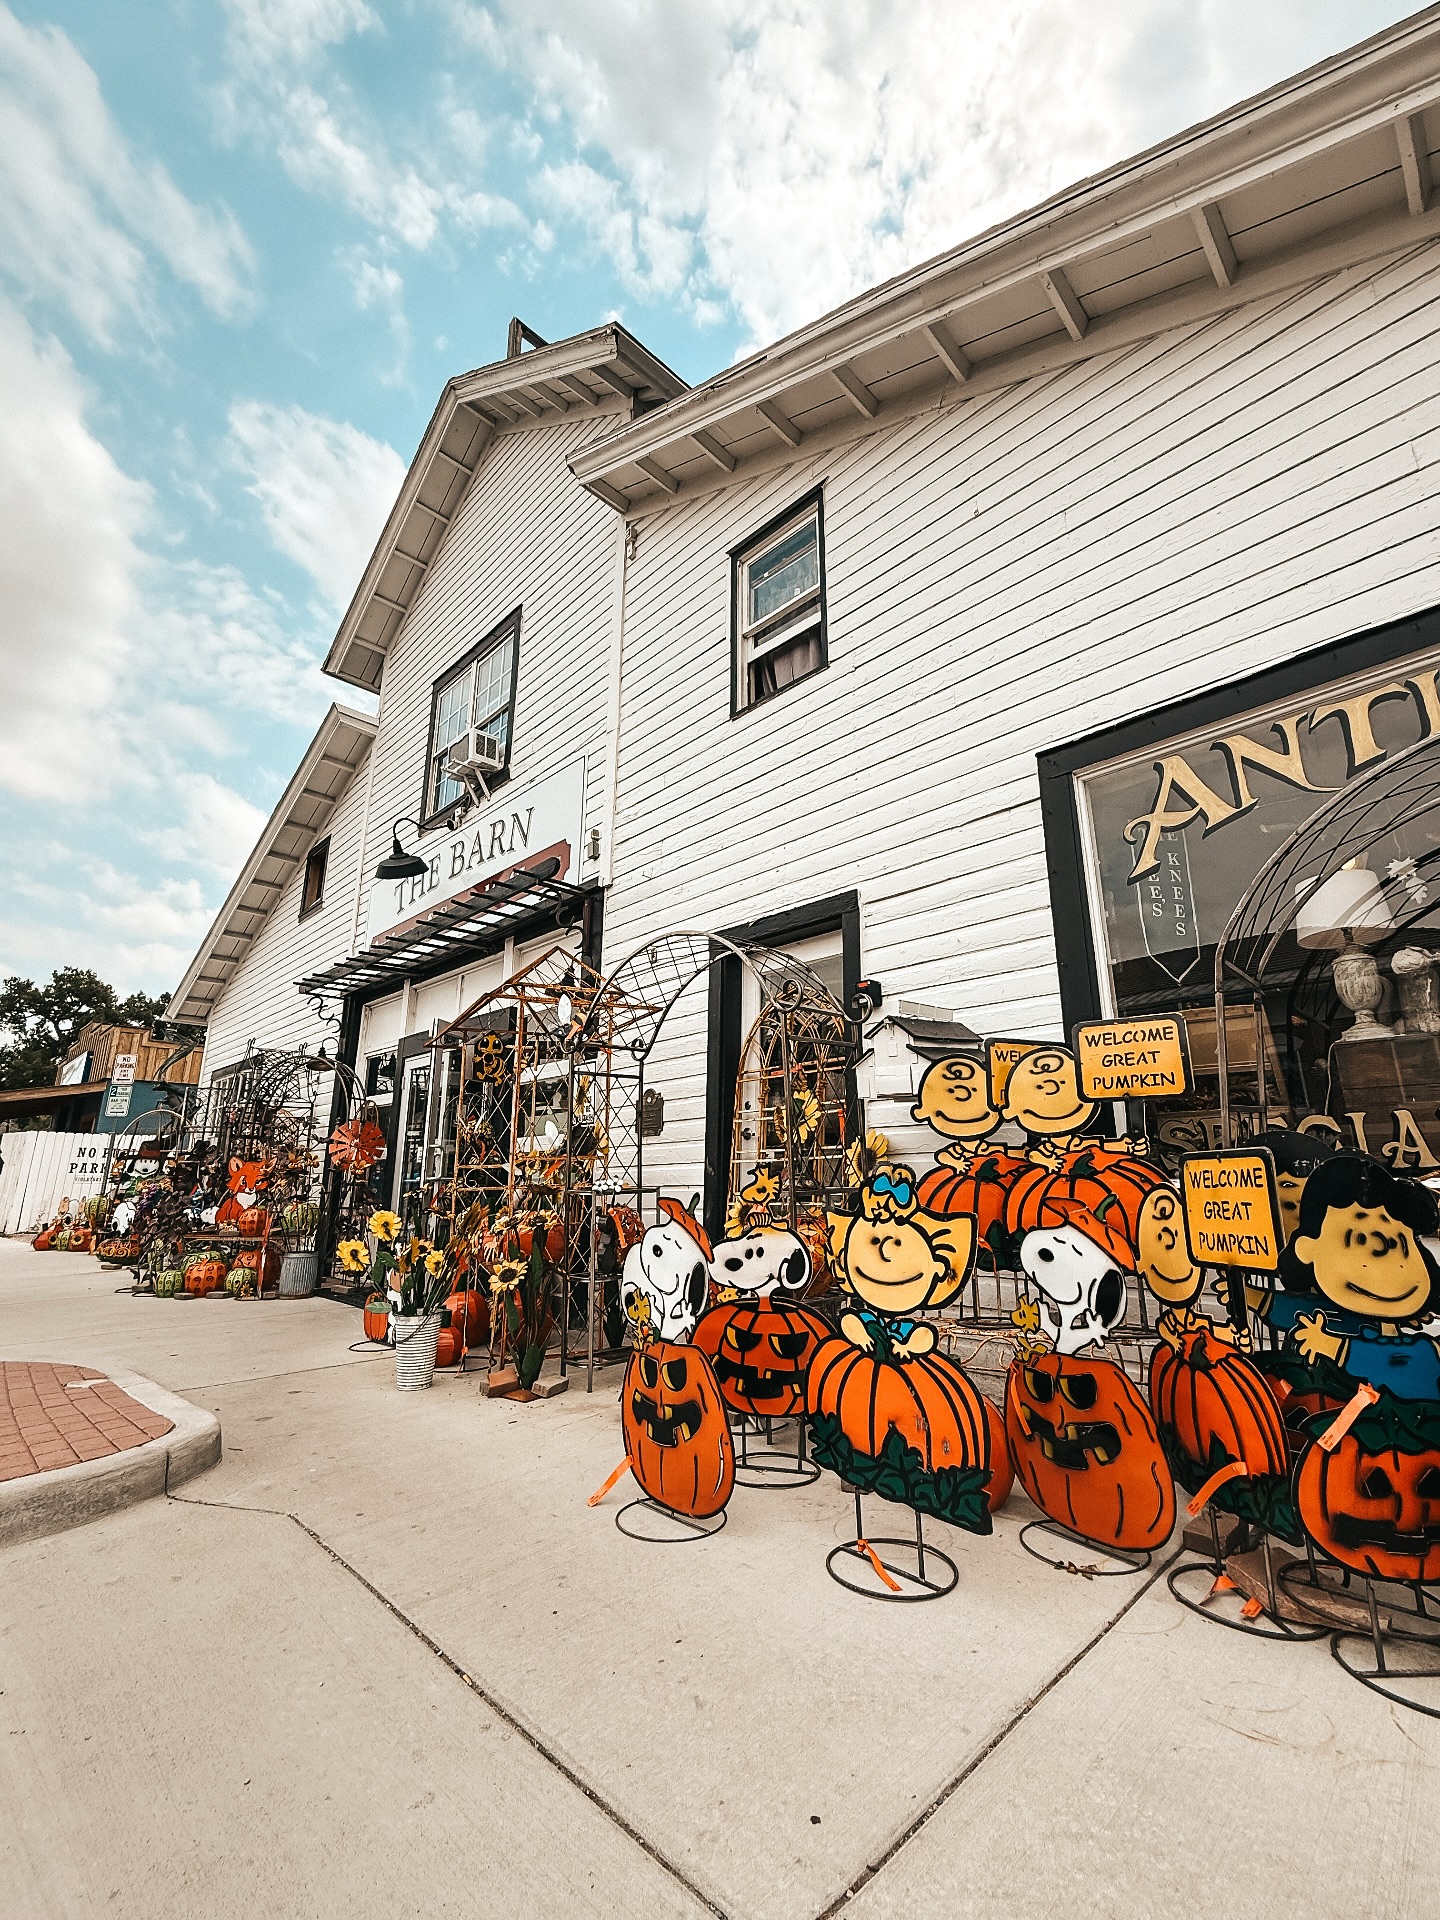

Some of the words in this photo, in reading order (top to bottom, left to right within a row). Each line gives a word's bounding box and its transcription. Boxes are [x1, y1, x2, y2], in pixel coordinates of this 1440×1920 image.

[393, 853, 441, 915] THE
[448, 806, 535, 880] BARN
[1166, 852, 1186, 936] KNEES
[1085, 1026, 1174, 1048] WELCOME
[1101, 1051, 1160, 1068] GREAT
[111, 1087, 117, 1096] 2
[1093, 1072, 1176, 1090] PUMPKIN
[77, 1147, 97, 1158] NO
[1189, 1167, 1264, 1189] WELCOME
[1203, 1201, 1253, 1221] GREAT
[1199, 1231, 1270, 1257] PUMPKIN
